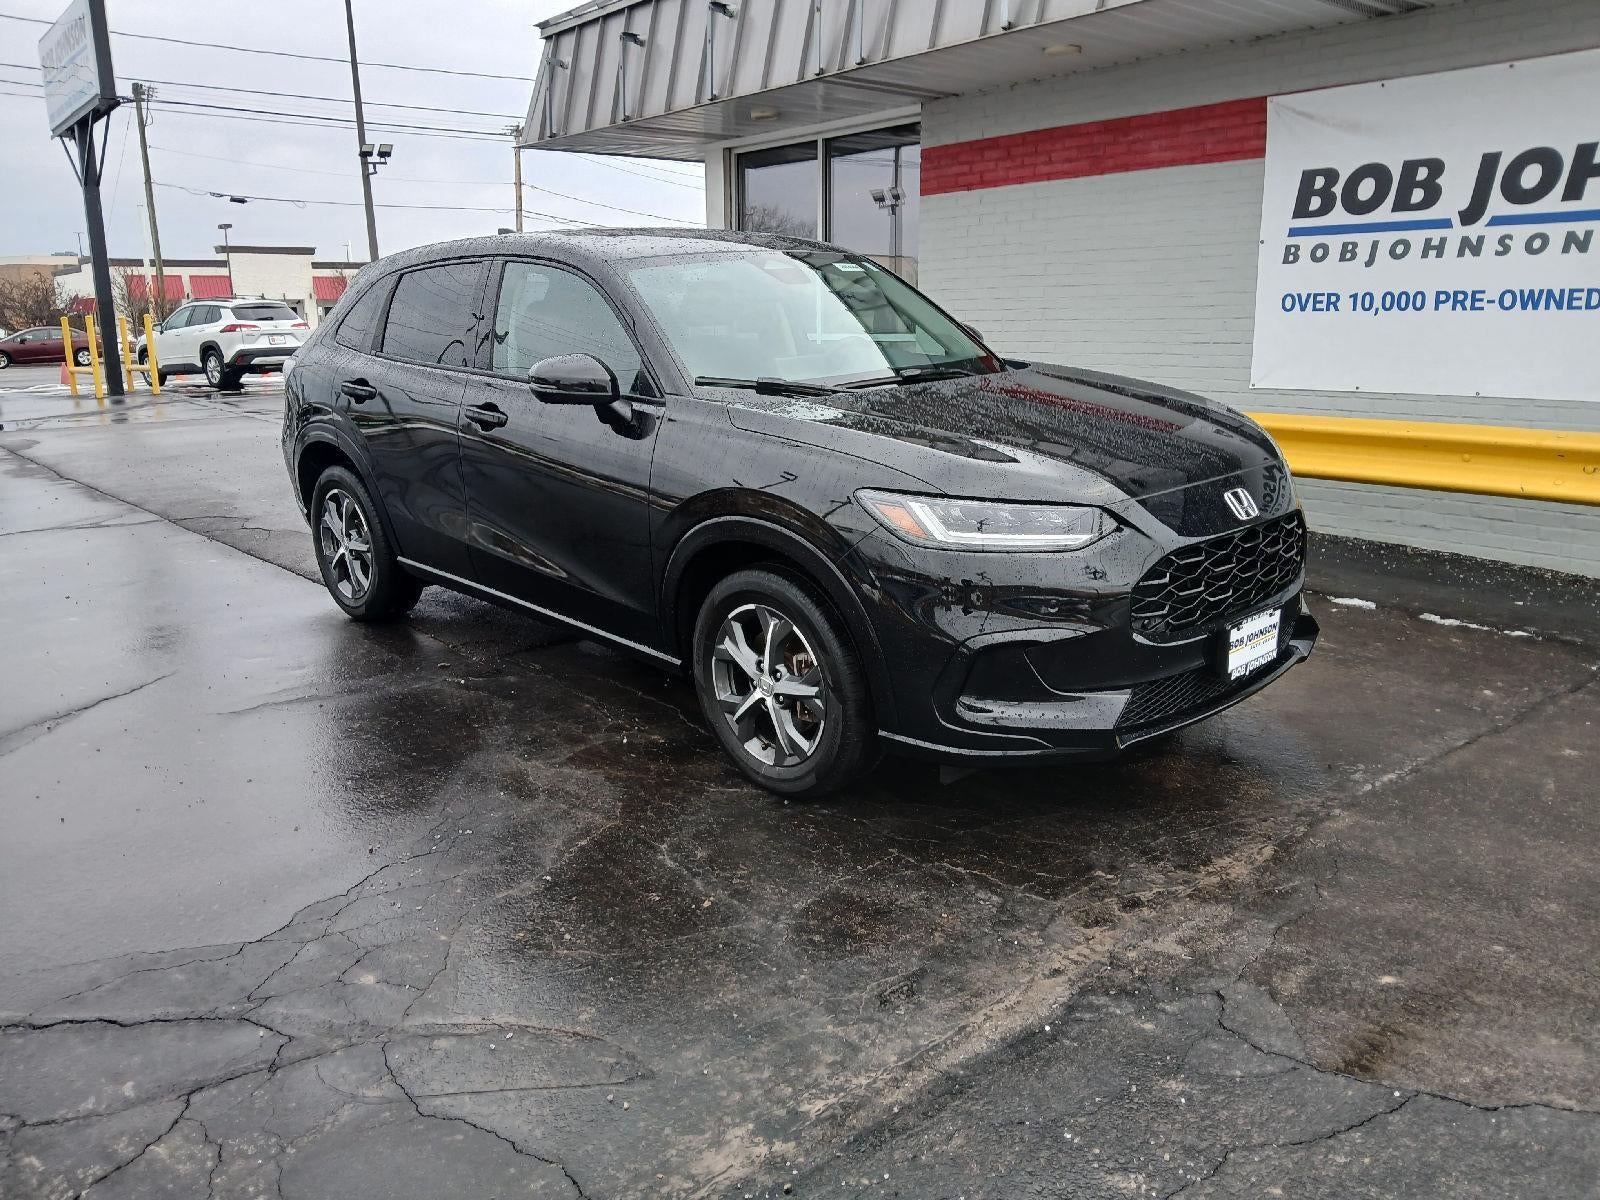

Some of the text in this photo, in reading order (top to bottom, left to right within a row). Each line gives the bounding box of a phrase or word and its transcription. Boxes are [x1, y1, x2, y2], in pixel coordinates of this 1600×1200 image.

[1292, 157, 1446, 220] BOB
[1281, 229, 1594, 268] BOBJOHNSON
[1281, 287, 1600, 316] OVER 10,000 PRE-OWNED
[1230, 622, 1279, 650] BOB JOHNSON
[1231, 649, 1278, 680] BOB JOHNSON
